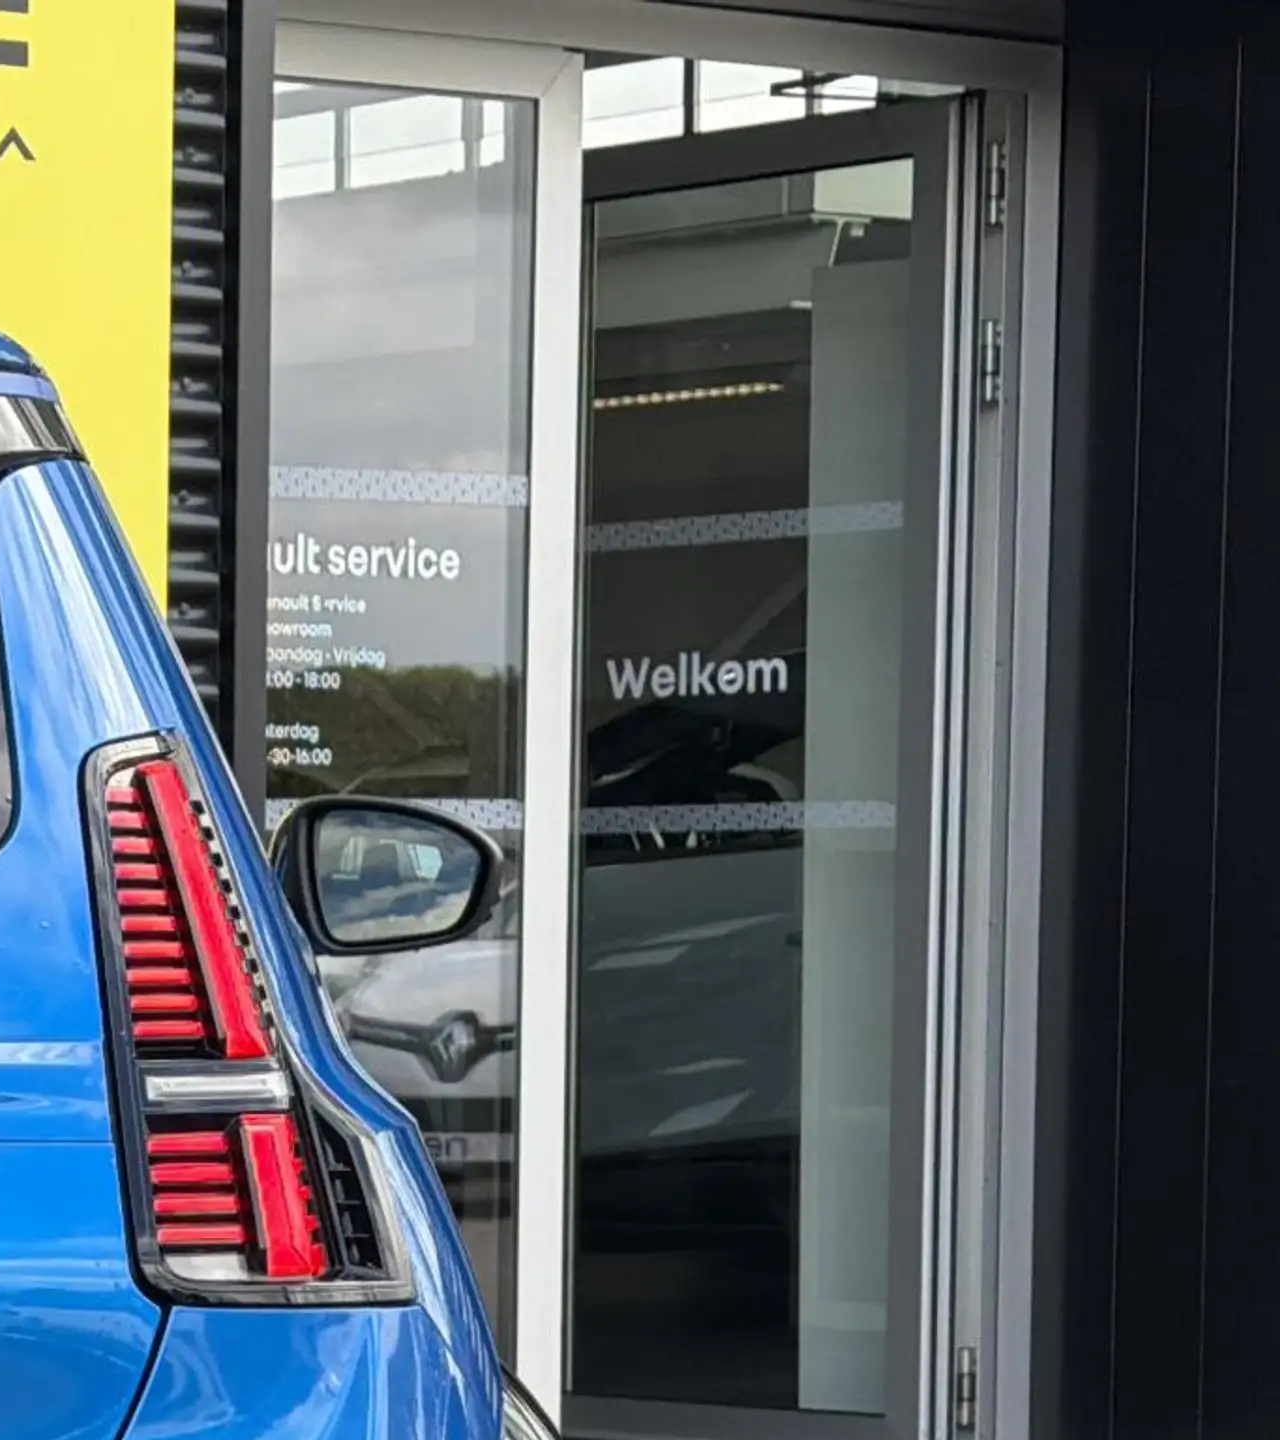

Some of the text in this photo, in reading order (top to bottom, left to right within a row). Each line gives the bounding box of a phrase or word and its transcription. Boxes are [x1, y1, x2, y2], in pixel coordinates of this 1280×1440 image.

[267, 532, 460, 580] ult service
[606, 651, 788, 700] Welkom
